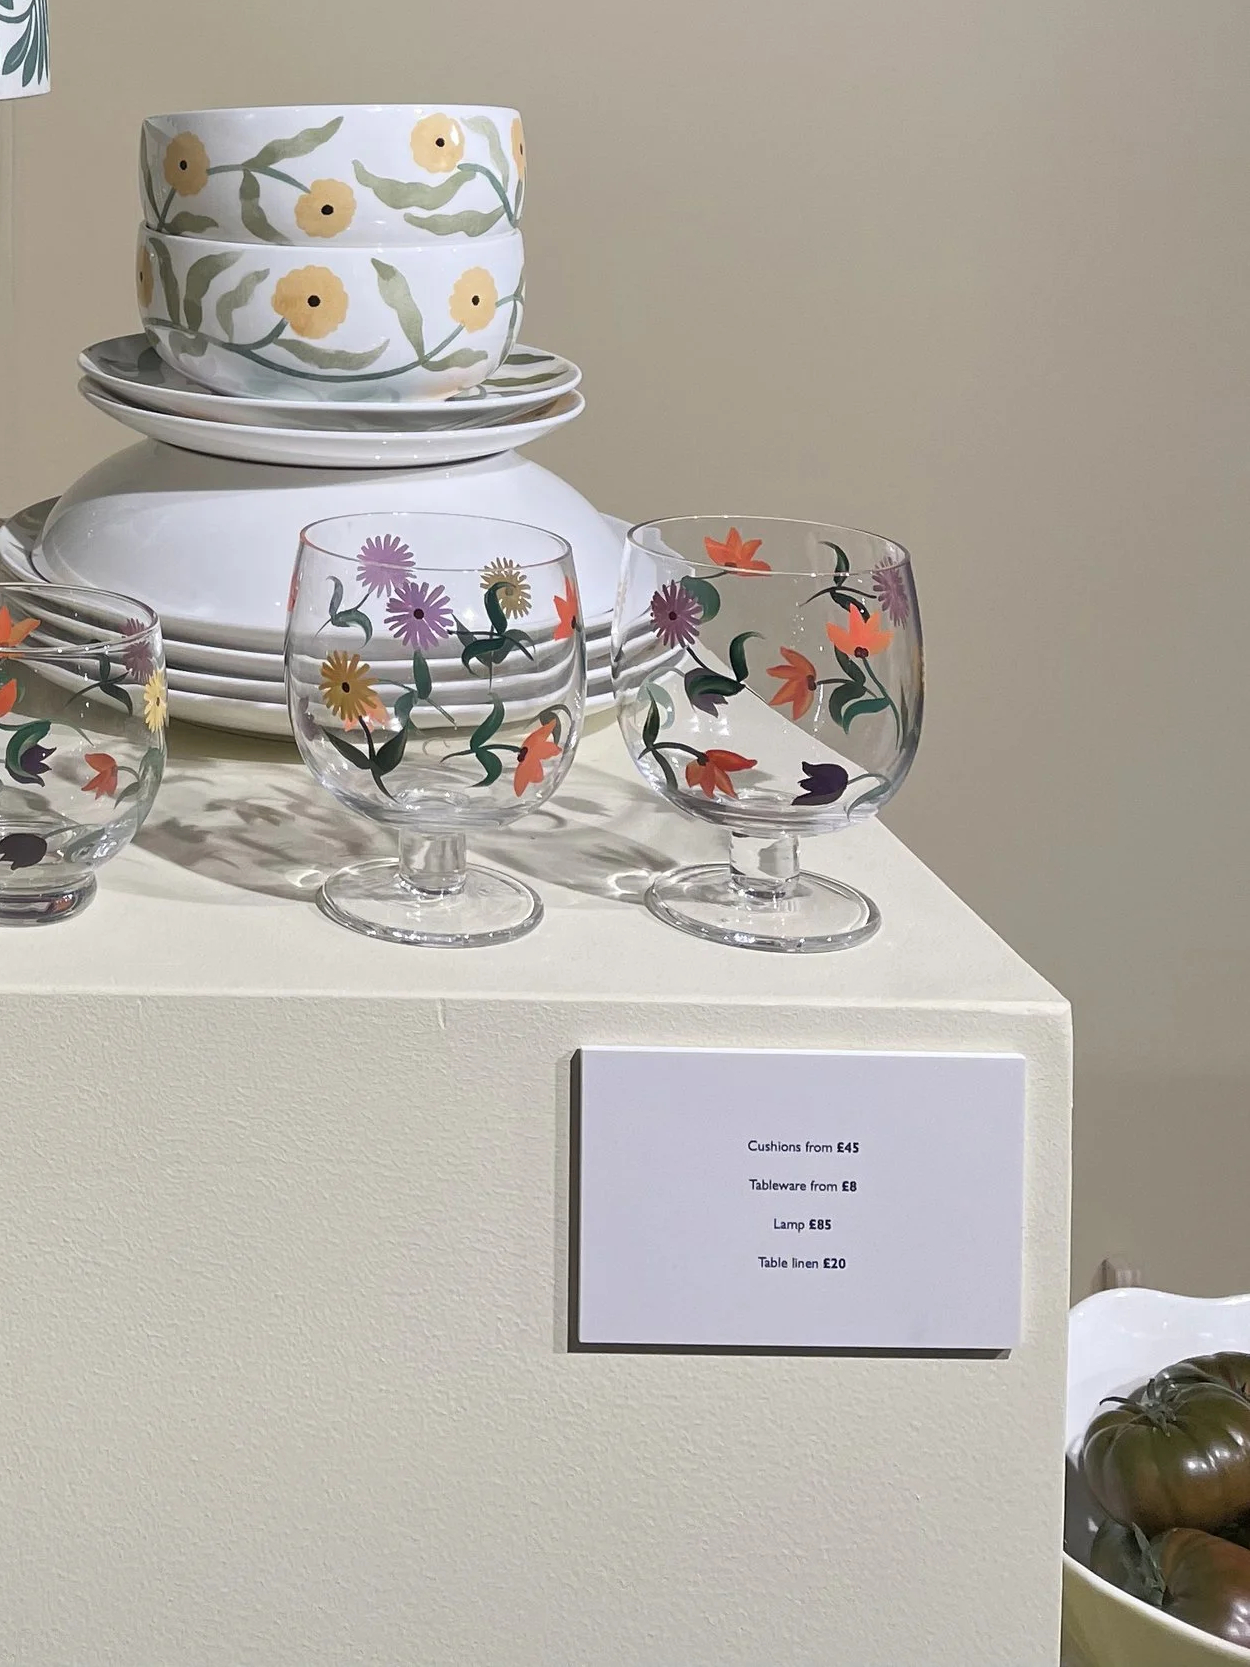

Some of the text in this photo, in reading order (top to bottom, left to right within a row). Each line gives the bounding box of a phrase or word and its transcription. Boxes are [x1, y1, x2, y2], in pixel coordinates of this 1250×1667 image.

[747, 1140, 859, 1153] Cushions from £45
[749, 1179, 857, 1192] Tableware from £8
[773, 1218, 831, 1233] Lamp £85
[758, 1257, 846, 1269] Table linen £20
